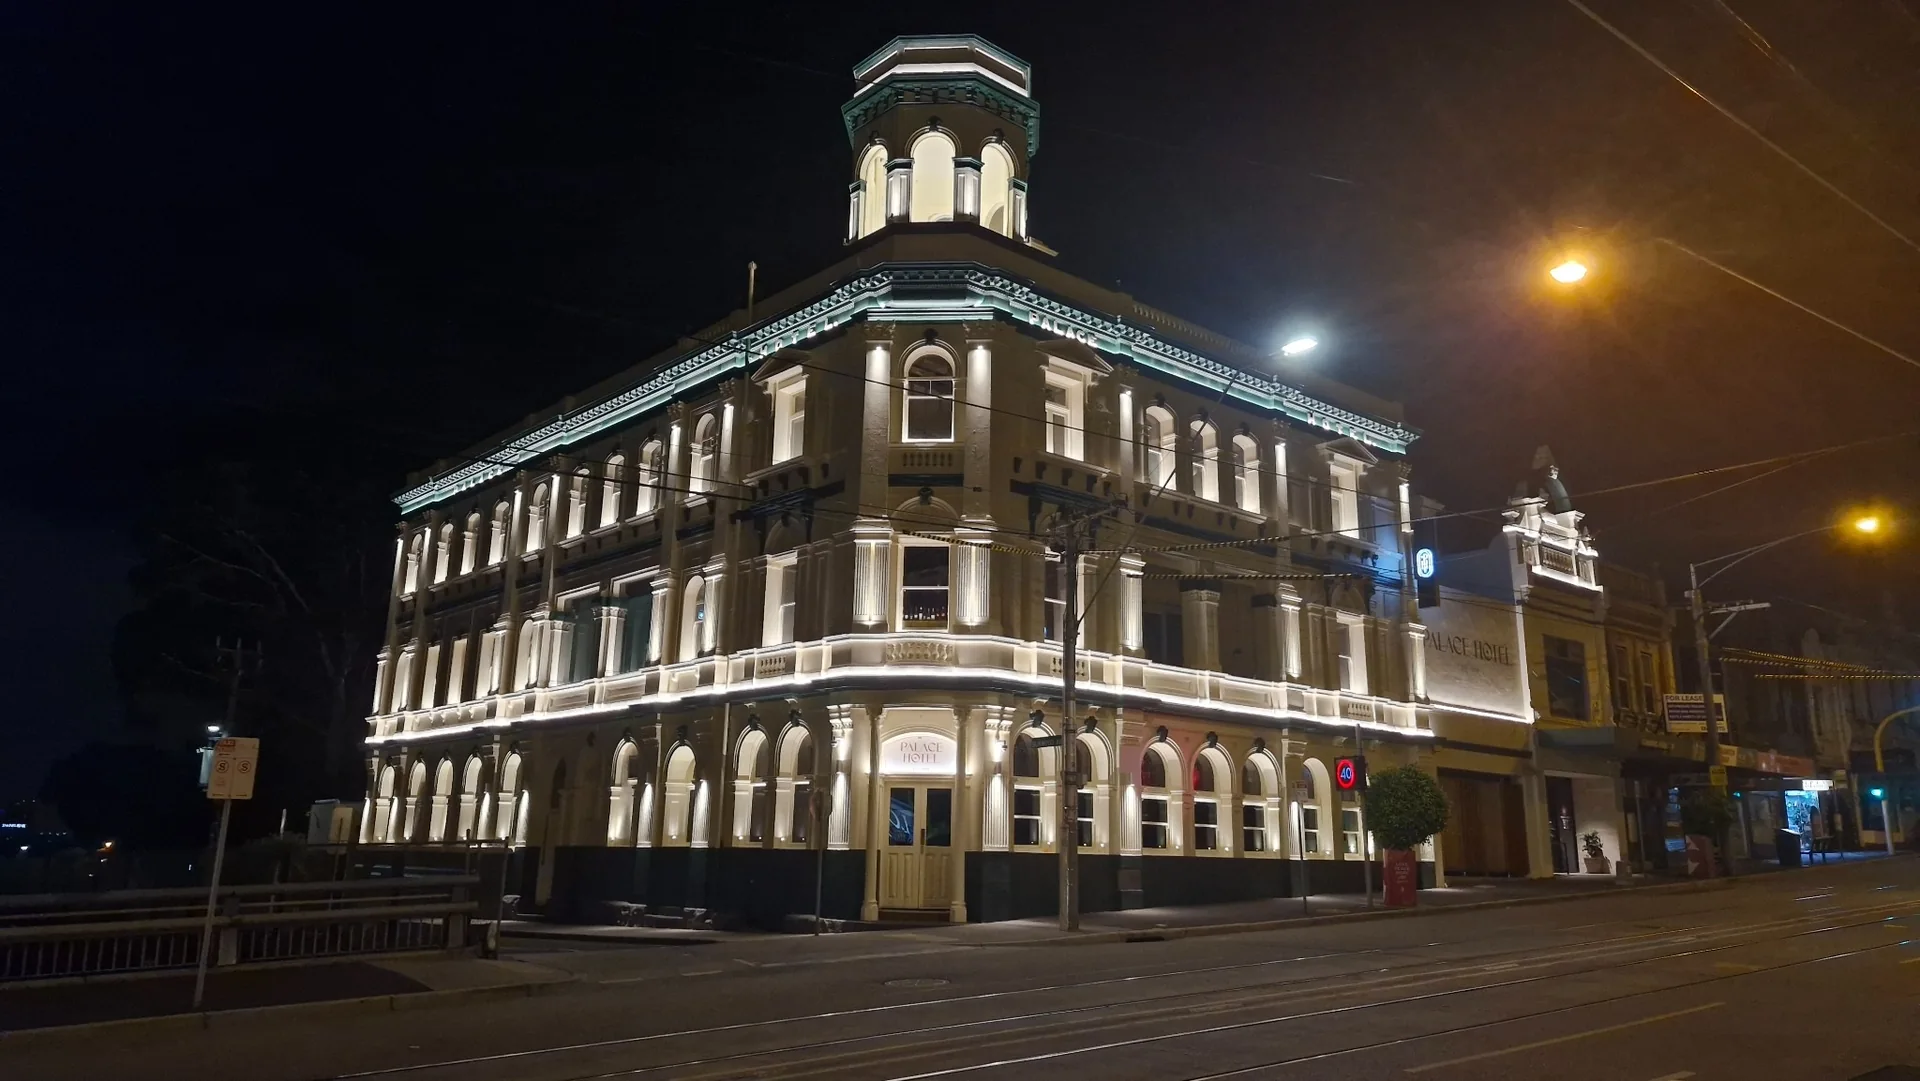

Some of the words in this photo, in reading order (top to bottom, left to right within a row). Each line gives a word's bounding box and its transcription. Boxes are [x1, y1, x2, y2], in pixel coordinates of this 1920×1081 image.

[1423, 628, 1470, 656] PALACE
[1473, 639, 1514, 666] HOTEL
[900, 742, 943, 753] PALACE
[903, 753, 941, 763] HOTEL
[1340, 767, 1353, 780] 40
